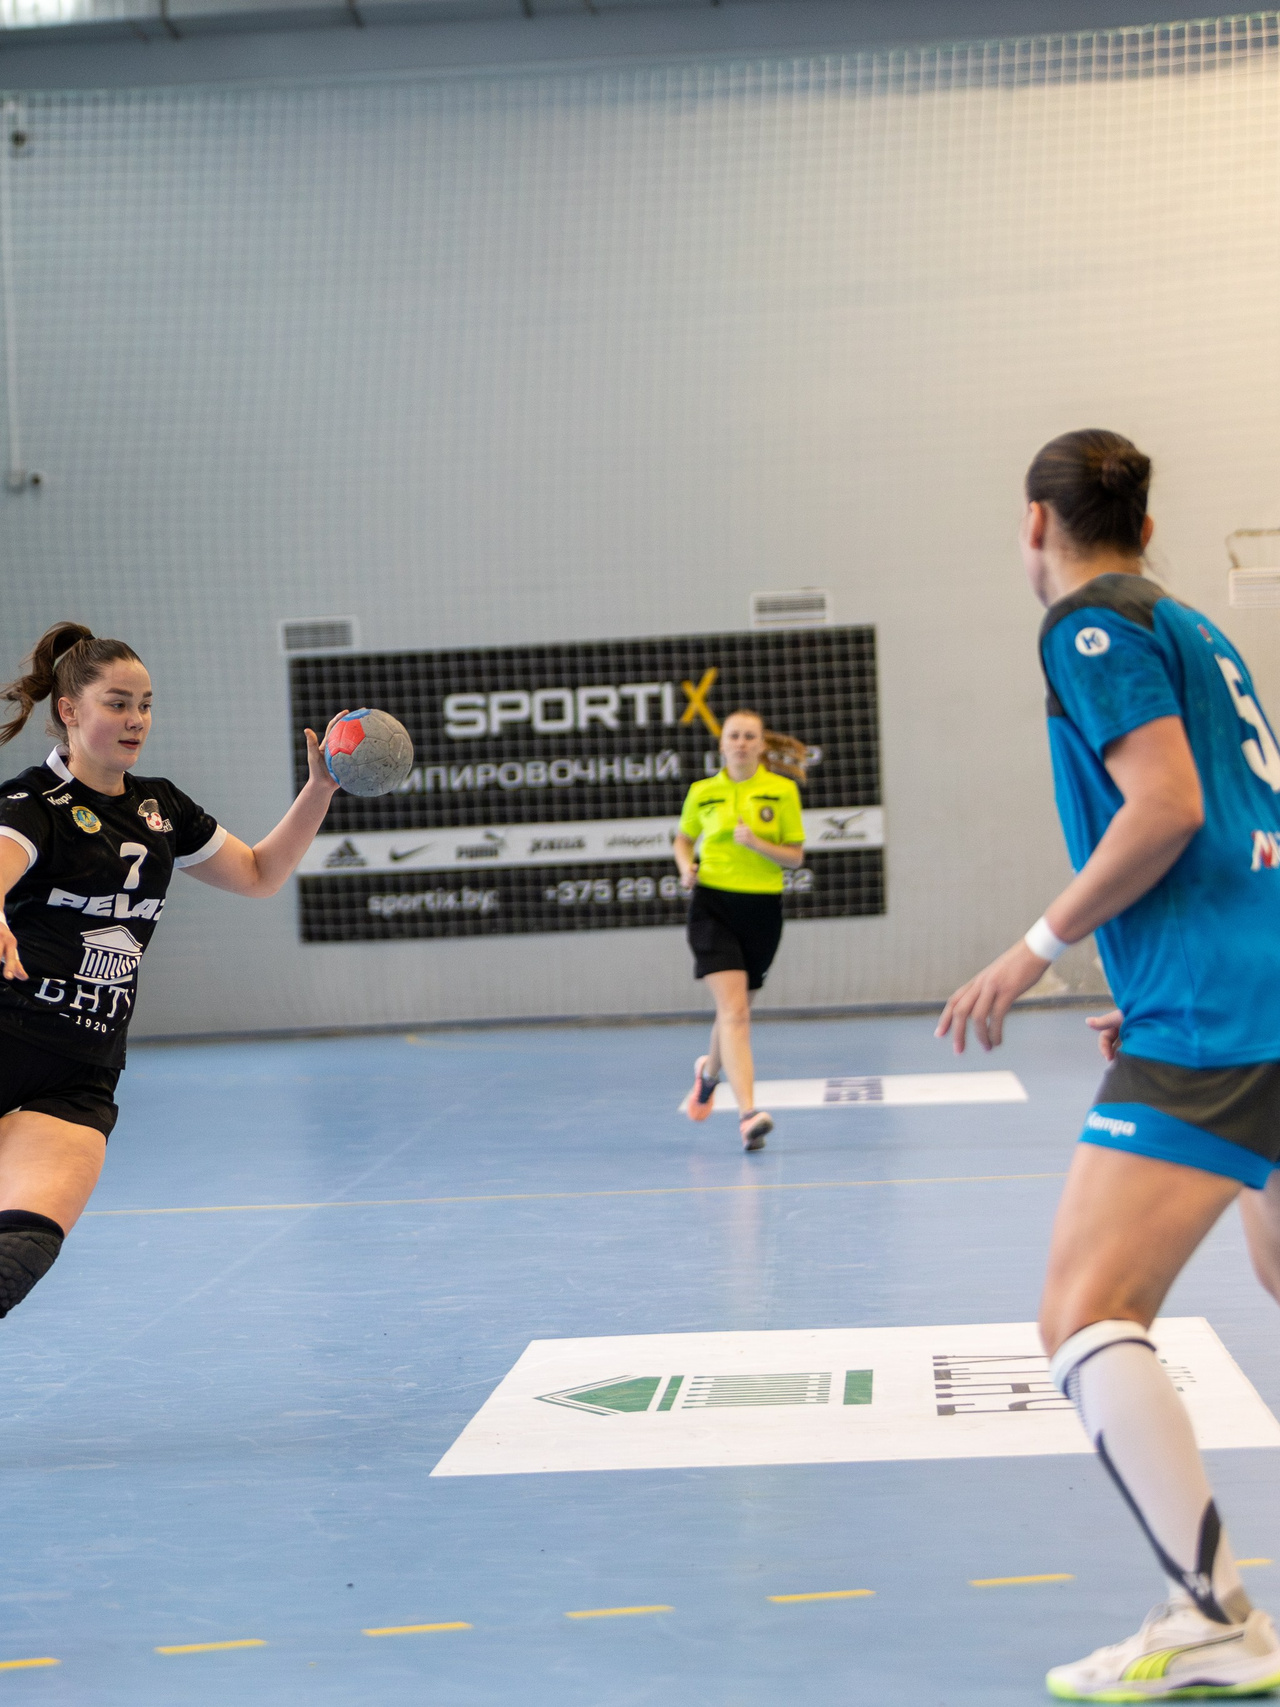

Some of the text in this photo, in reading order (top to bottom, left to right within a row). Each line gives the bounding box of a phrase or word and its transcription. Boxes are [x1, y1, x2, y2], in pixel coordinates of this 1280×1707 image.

[444, 666, 721, 739] SPORTIX
[391, 750, 681, 795] ИПИРОВОЧНЫЙ
[46, 792, 74, 807] Kmpa
[119, 841, 149, 891] 7
[75, 1015, 107, 1033] 1920
